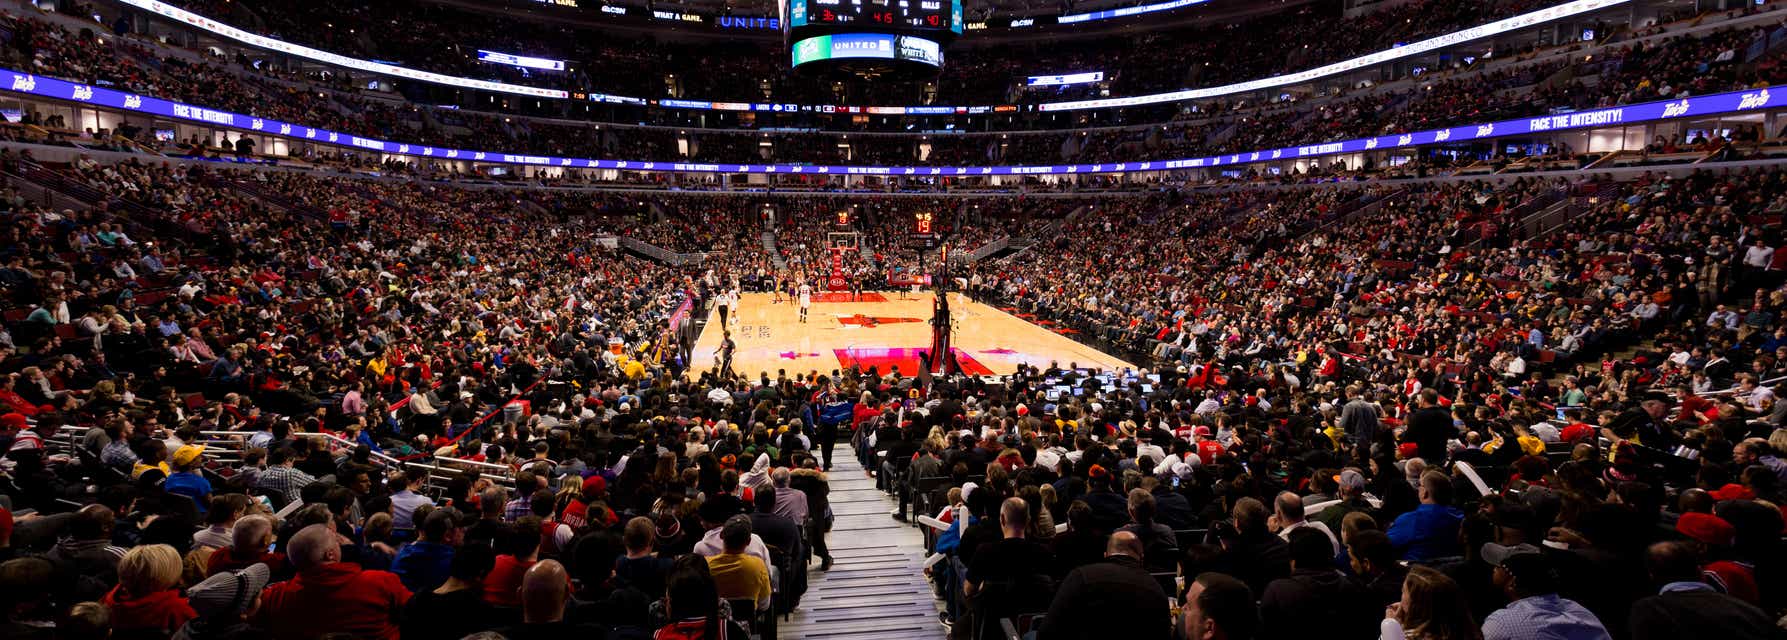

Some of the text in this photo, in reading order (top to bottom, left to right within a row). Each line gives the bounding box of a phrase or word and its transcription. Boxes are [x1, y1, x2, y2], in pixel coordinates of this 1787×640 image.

[921, 1, 940, 9] BULLS
[610, 7, 626, 15] CSN
[654, 11, 674, 20] WHAT
[682, 13, 703, 22] GAME.
[720, 16, 779, 30] UNITE
[927, 15, 939, 26] 40
[967, 22, 988, 30] GAME.
[834, 41, 877, 50] UNITED
[173, 103, 190, 118] FACE
[190, 107, 203, 120] THE
[1530, 109, 1623, 131] FACE THE INTENSITY!
[918, 220, 929, 232] 19
[831, 278, 844, 286] KIA
